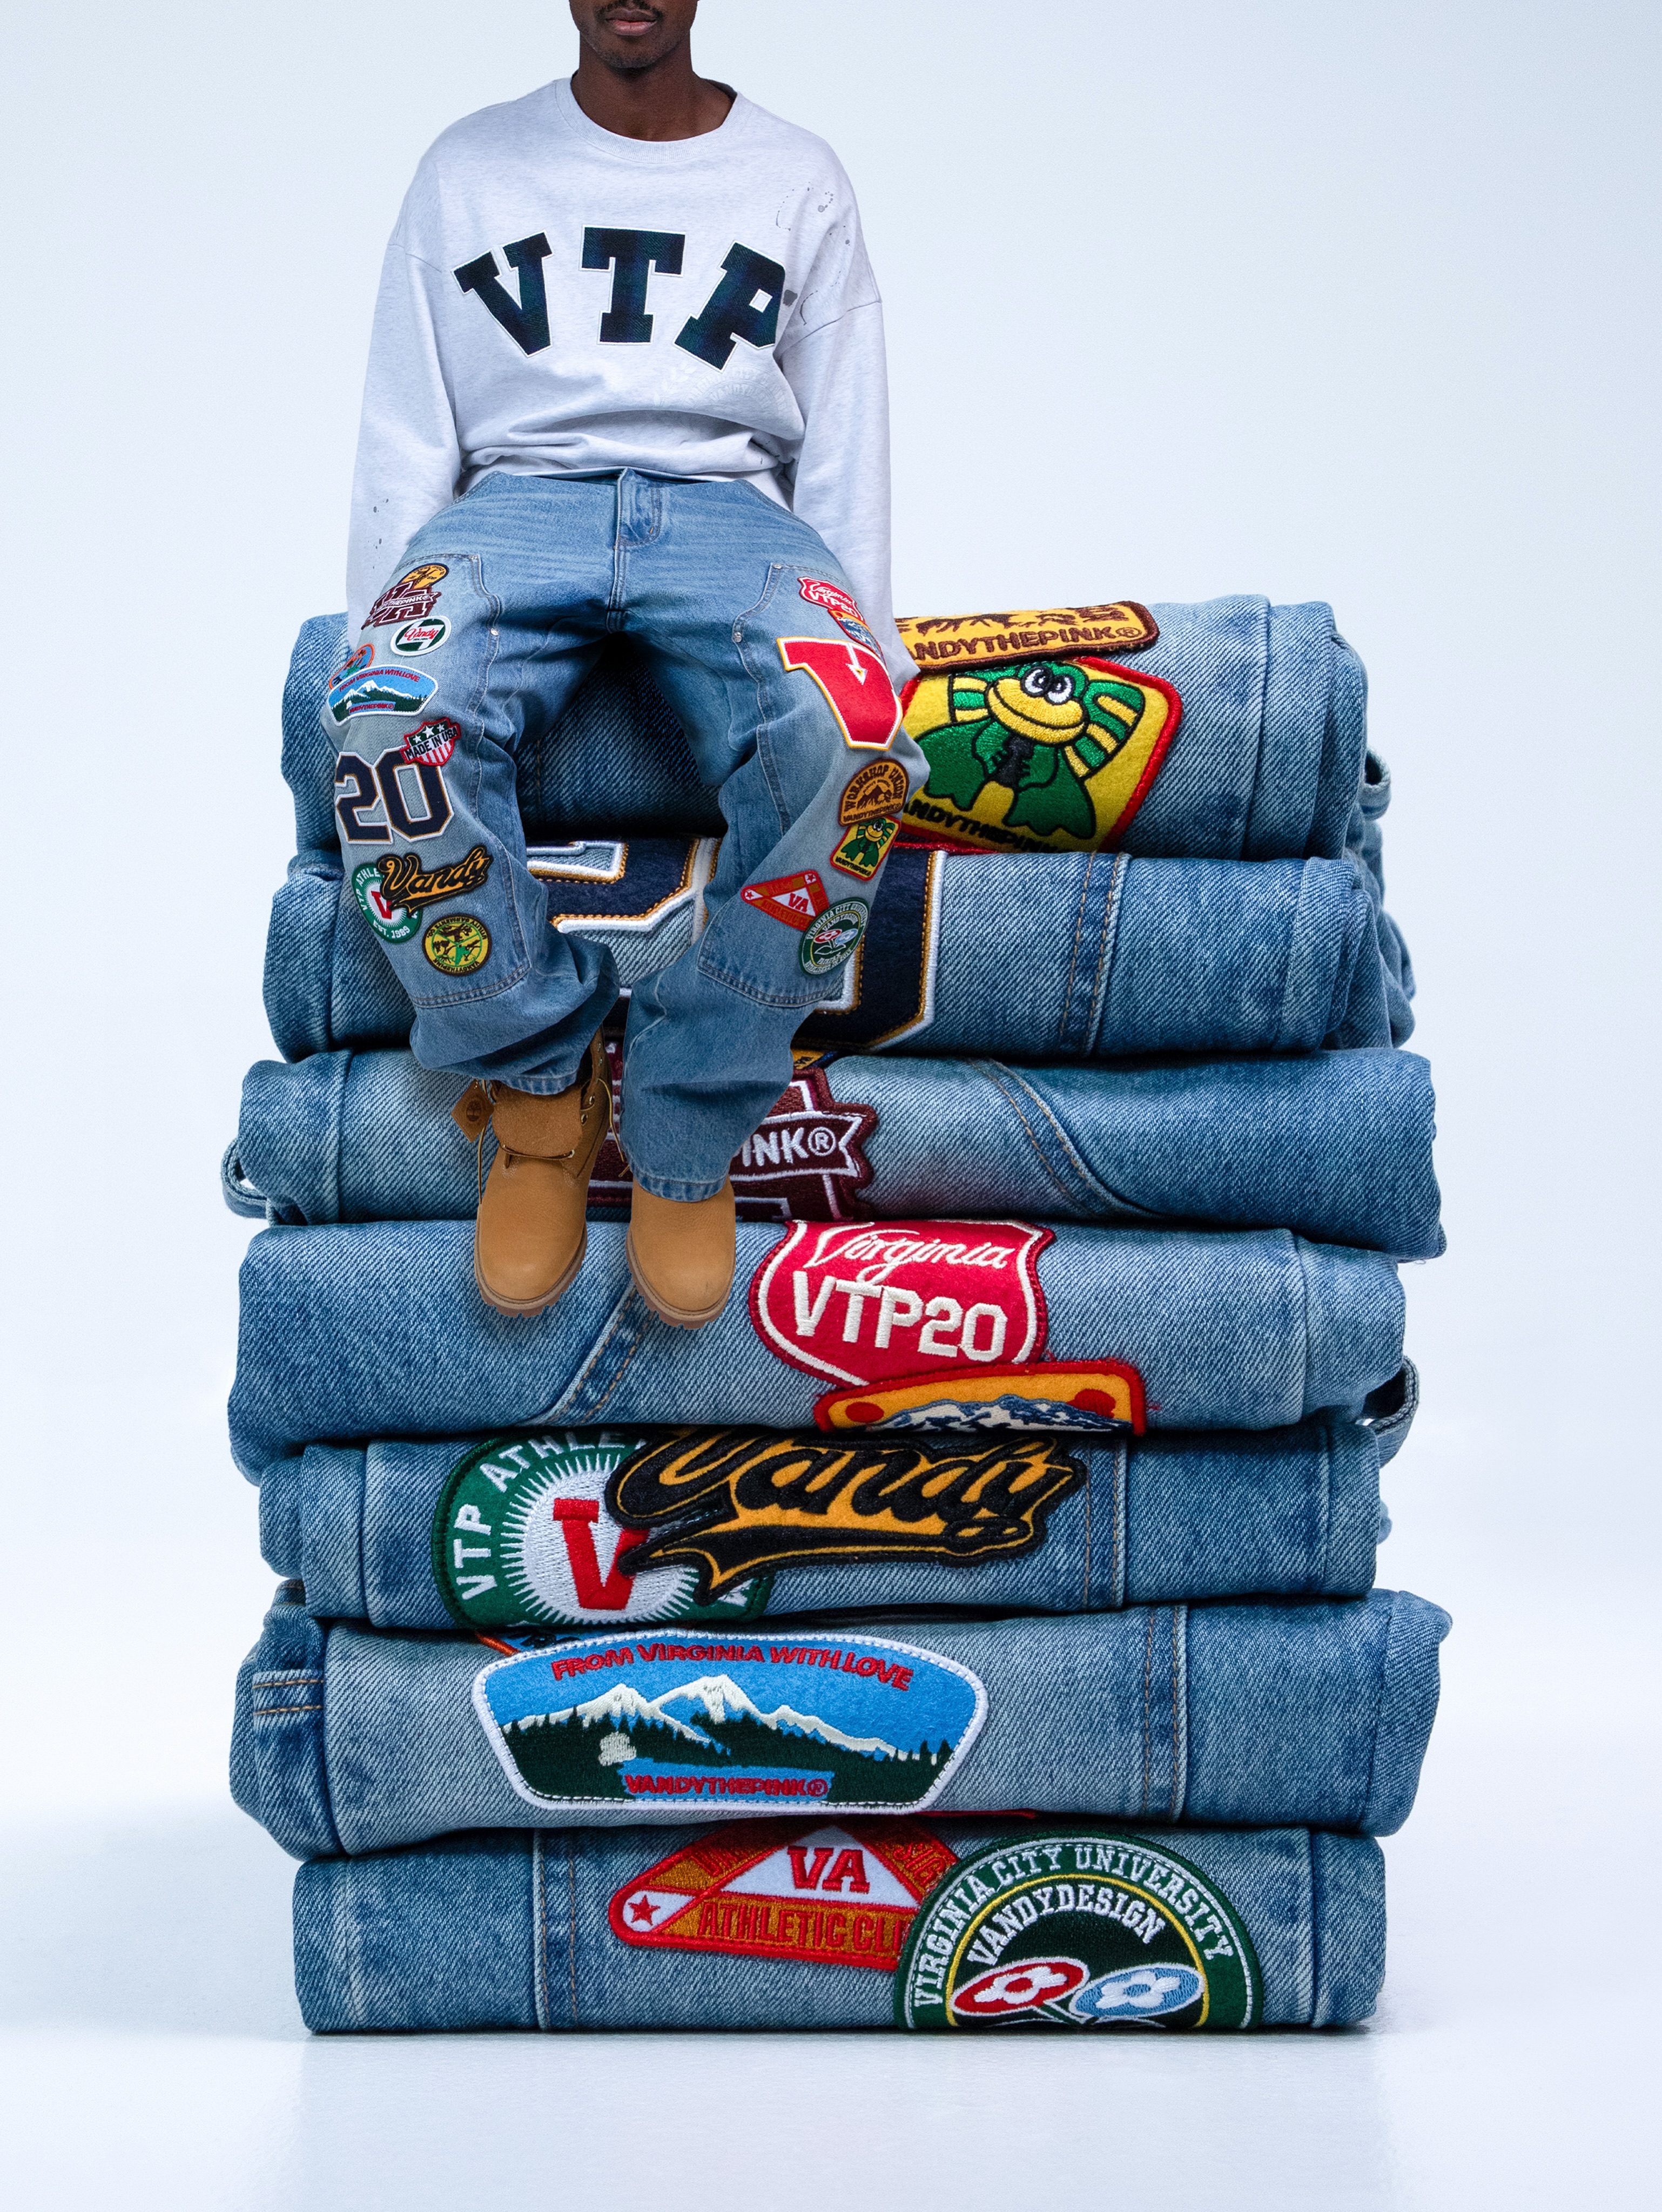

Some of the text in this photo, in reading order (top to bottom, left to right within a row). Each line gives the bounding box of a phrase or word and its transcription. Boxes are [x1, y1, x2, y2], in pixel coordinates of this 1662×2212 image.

[450, 224, 786, 373] VTP
[808, 590, 858, 618] VTP20
[404, 628, 439, 641] Vandy
[906, 626, 1143, 660] NDYTHEPINK®
[339, 678, 355, 692] FROM
[356, 669, 383, 680] VIRGINIA
[385, 669, 402, 677] WITH
[402, 671, 421, 683] LOVE
[406, 727, 458, 760] MADE IN USA
[335, 745, 454, 845] 20
[356, 867, 385, 911] VTP ATHLE
[378, 846, 491, 901] Vandy
[788, 892, 809, 913] VA
[806, 911, 835, 940] VIRGINIA
[373, 919, 411, 939] EST. 1989
[732, 1127, 837, 1167] INK®
[803, 1220, 1015, 1285] Virginia
[793, 1270, 1008, 1362] VTP20
[453, 1432, 647, 1600] VTP ATHLE
[610, 1431, 1079, 1558] Vandy
[553, 1497, 650, 1610] V
[551, 1643, 914, 1691] FROM VIRGINIA WITH LOVE
[787, 1845, 870, 1894] VA
[697, 1903, 846, 1947] ATHLETIC
[914, 1845, 1234, 2007] VIRGINIA CITY UNIVERSITY
[966, 1885, 1167, 1966] VANDYDESIGN
